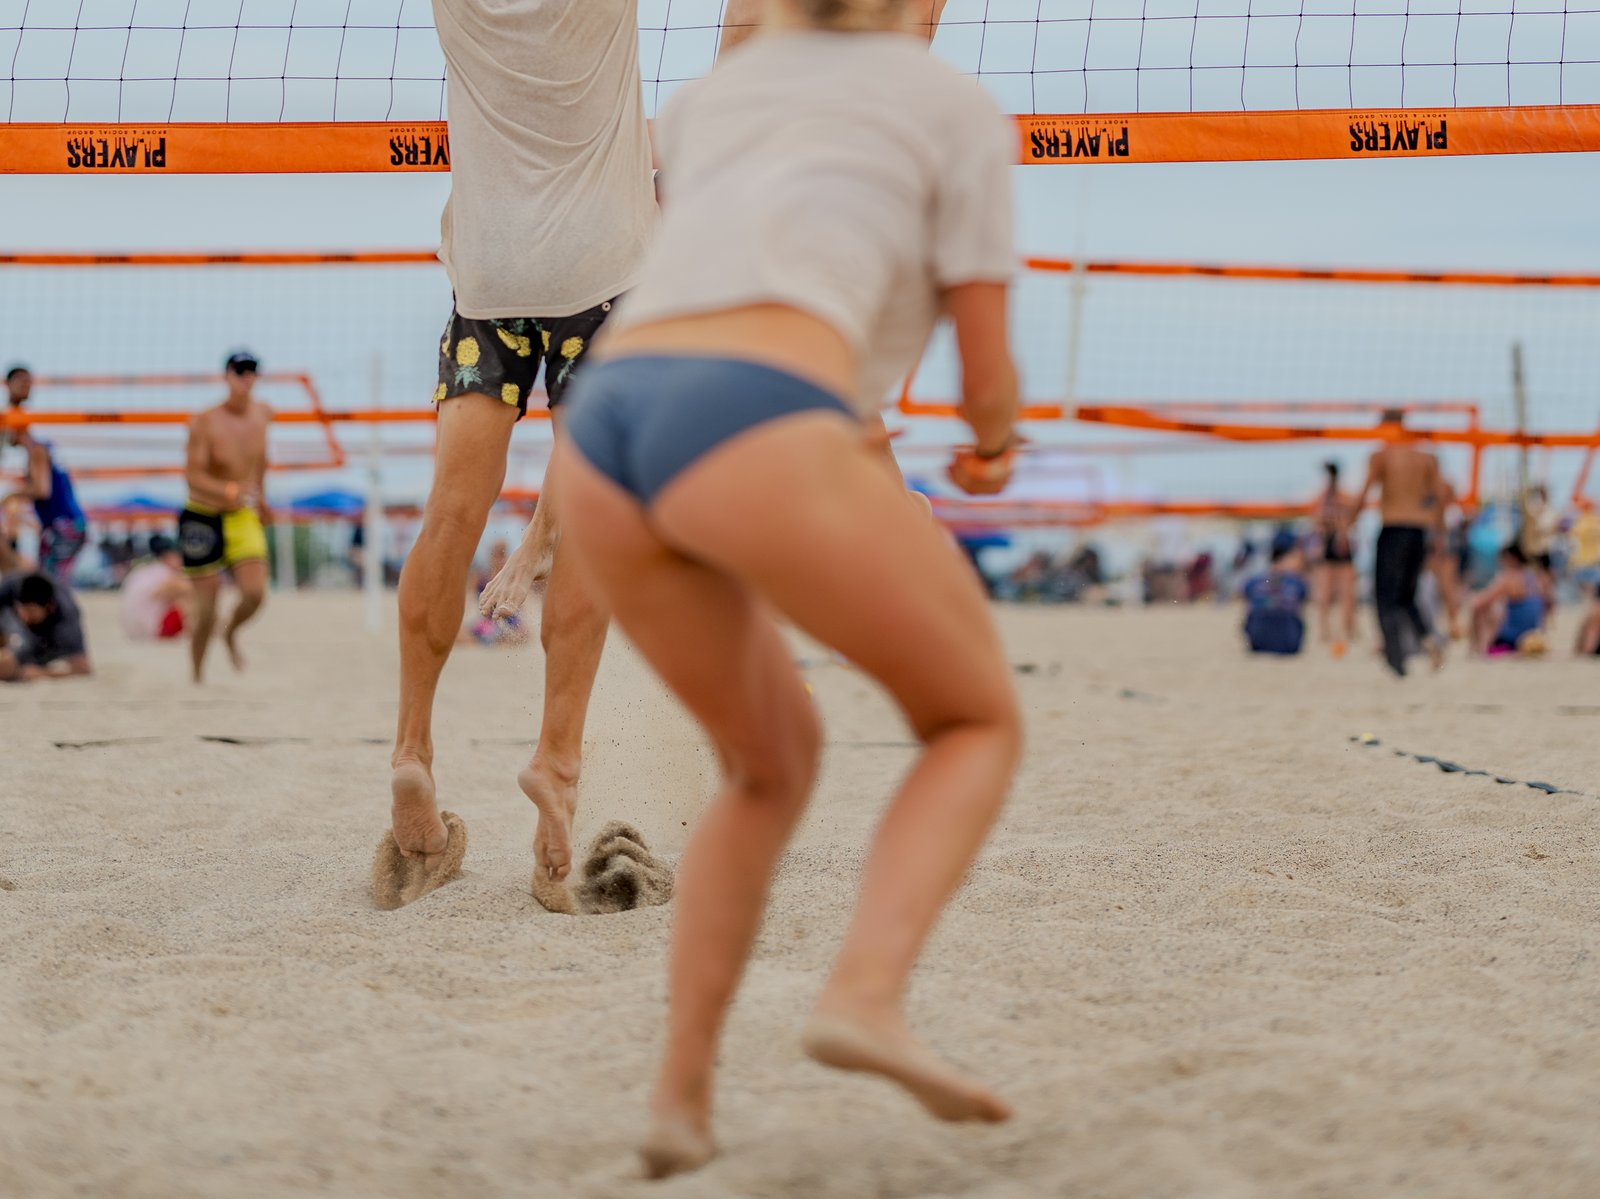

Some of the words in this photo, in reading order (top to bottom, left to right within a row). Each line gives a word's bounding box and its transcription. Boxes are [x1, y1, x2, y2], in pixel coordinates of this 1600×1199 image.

[390, 135, 450, 166] YERS
[1031, 127, 1129, 158] PLAYERS
[1349, 120, 1447, 152] PLAYERS
[67, 137, 166, 168] PLAYERS
